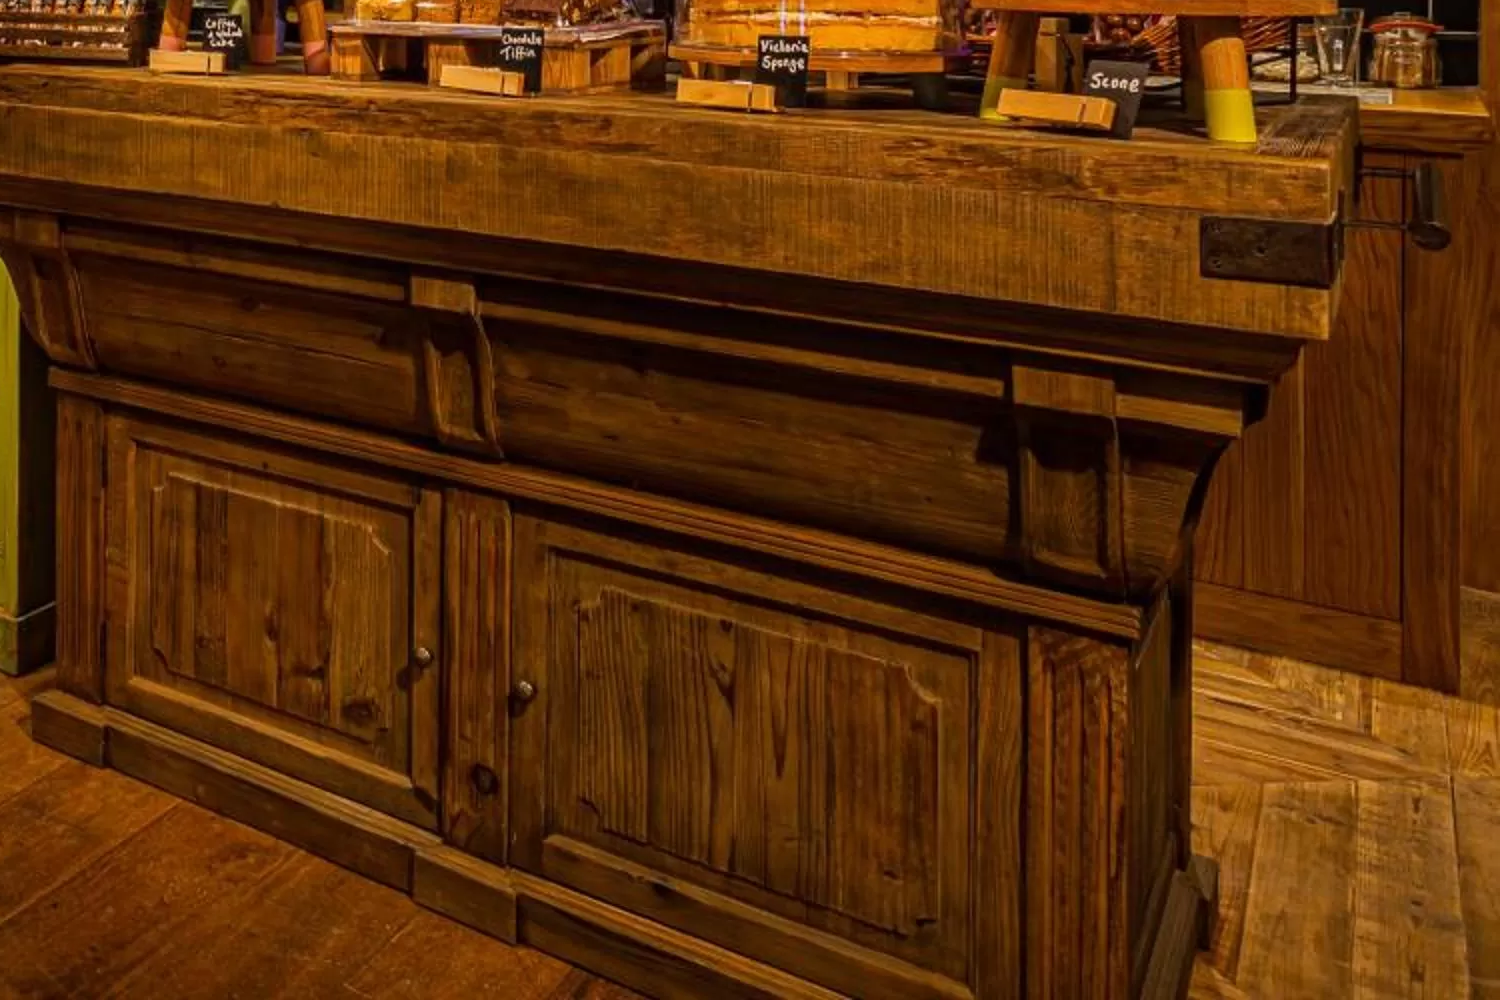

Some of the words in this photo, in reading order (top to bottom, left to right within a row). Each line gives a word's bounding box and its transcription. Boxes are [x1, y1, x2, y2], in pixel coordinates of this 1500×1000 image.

[500, 45, 537, 61] Tiffin
[761, 39, 809, 53] Victoria
[762, 55, 805, 73] Sponge
[1090, 72, 1139, 93] Scone
